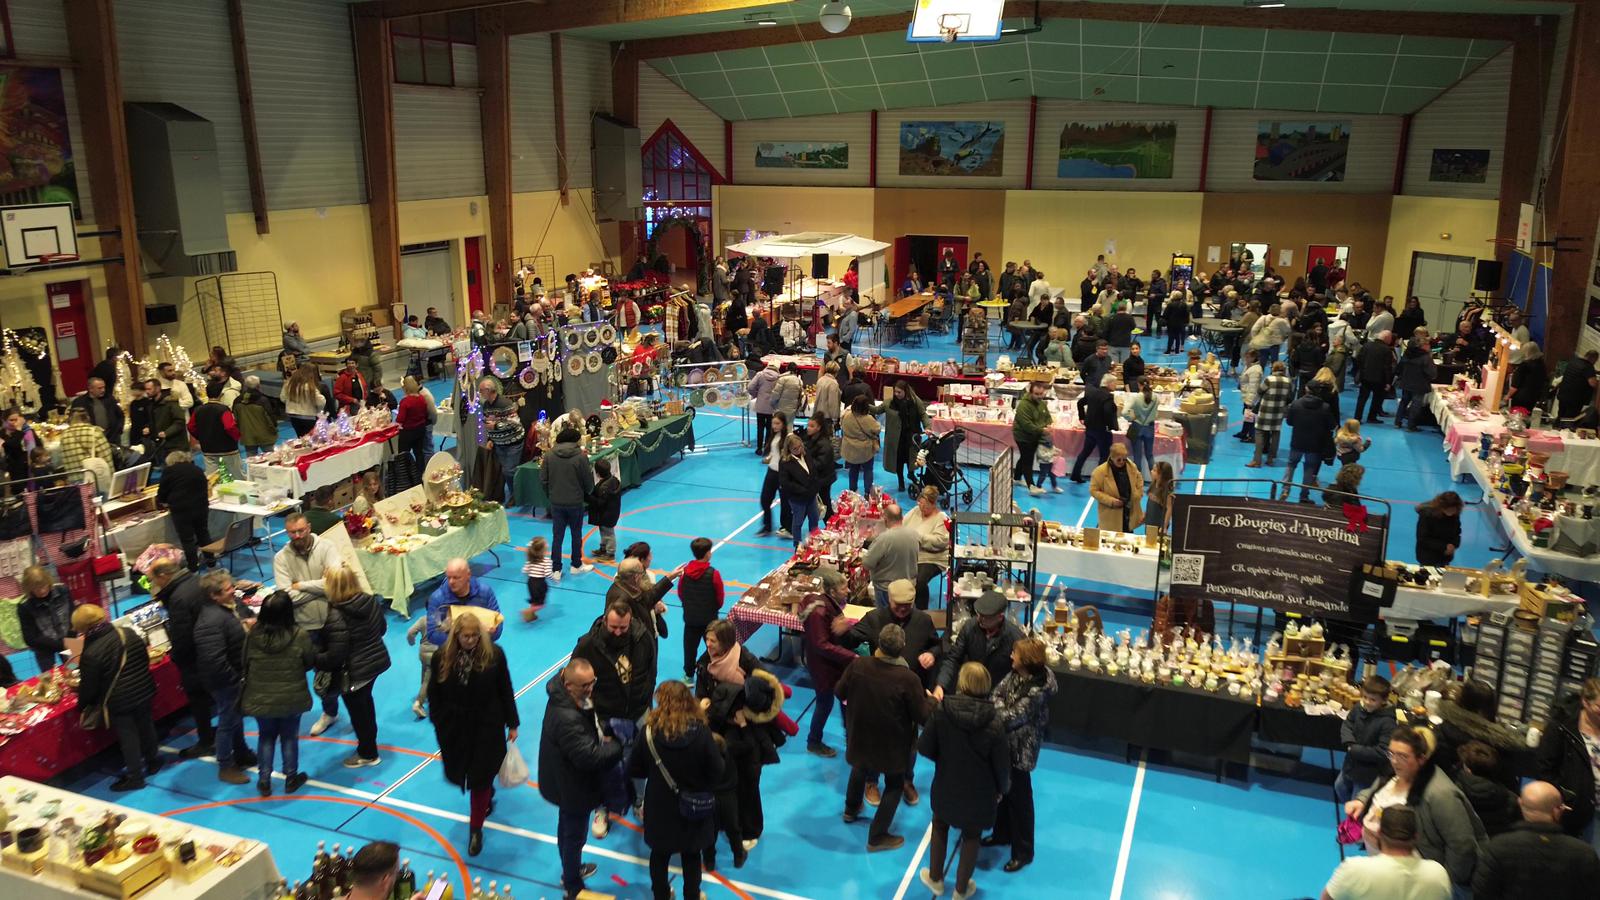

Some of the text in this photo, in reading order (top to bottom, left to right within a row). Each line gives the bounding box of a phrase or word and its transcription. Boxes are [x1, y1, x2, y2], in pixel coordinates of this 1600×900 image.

[1209, 514, 1231, 528] Les
[1233, 513, 1287, 535] Bougies
[1286, 594, 1305, 605] sur
[1305, 596, 1350, 613] demande
